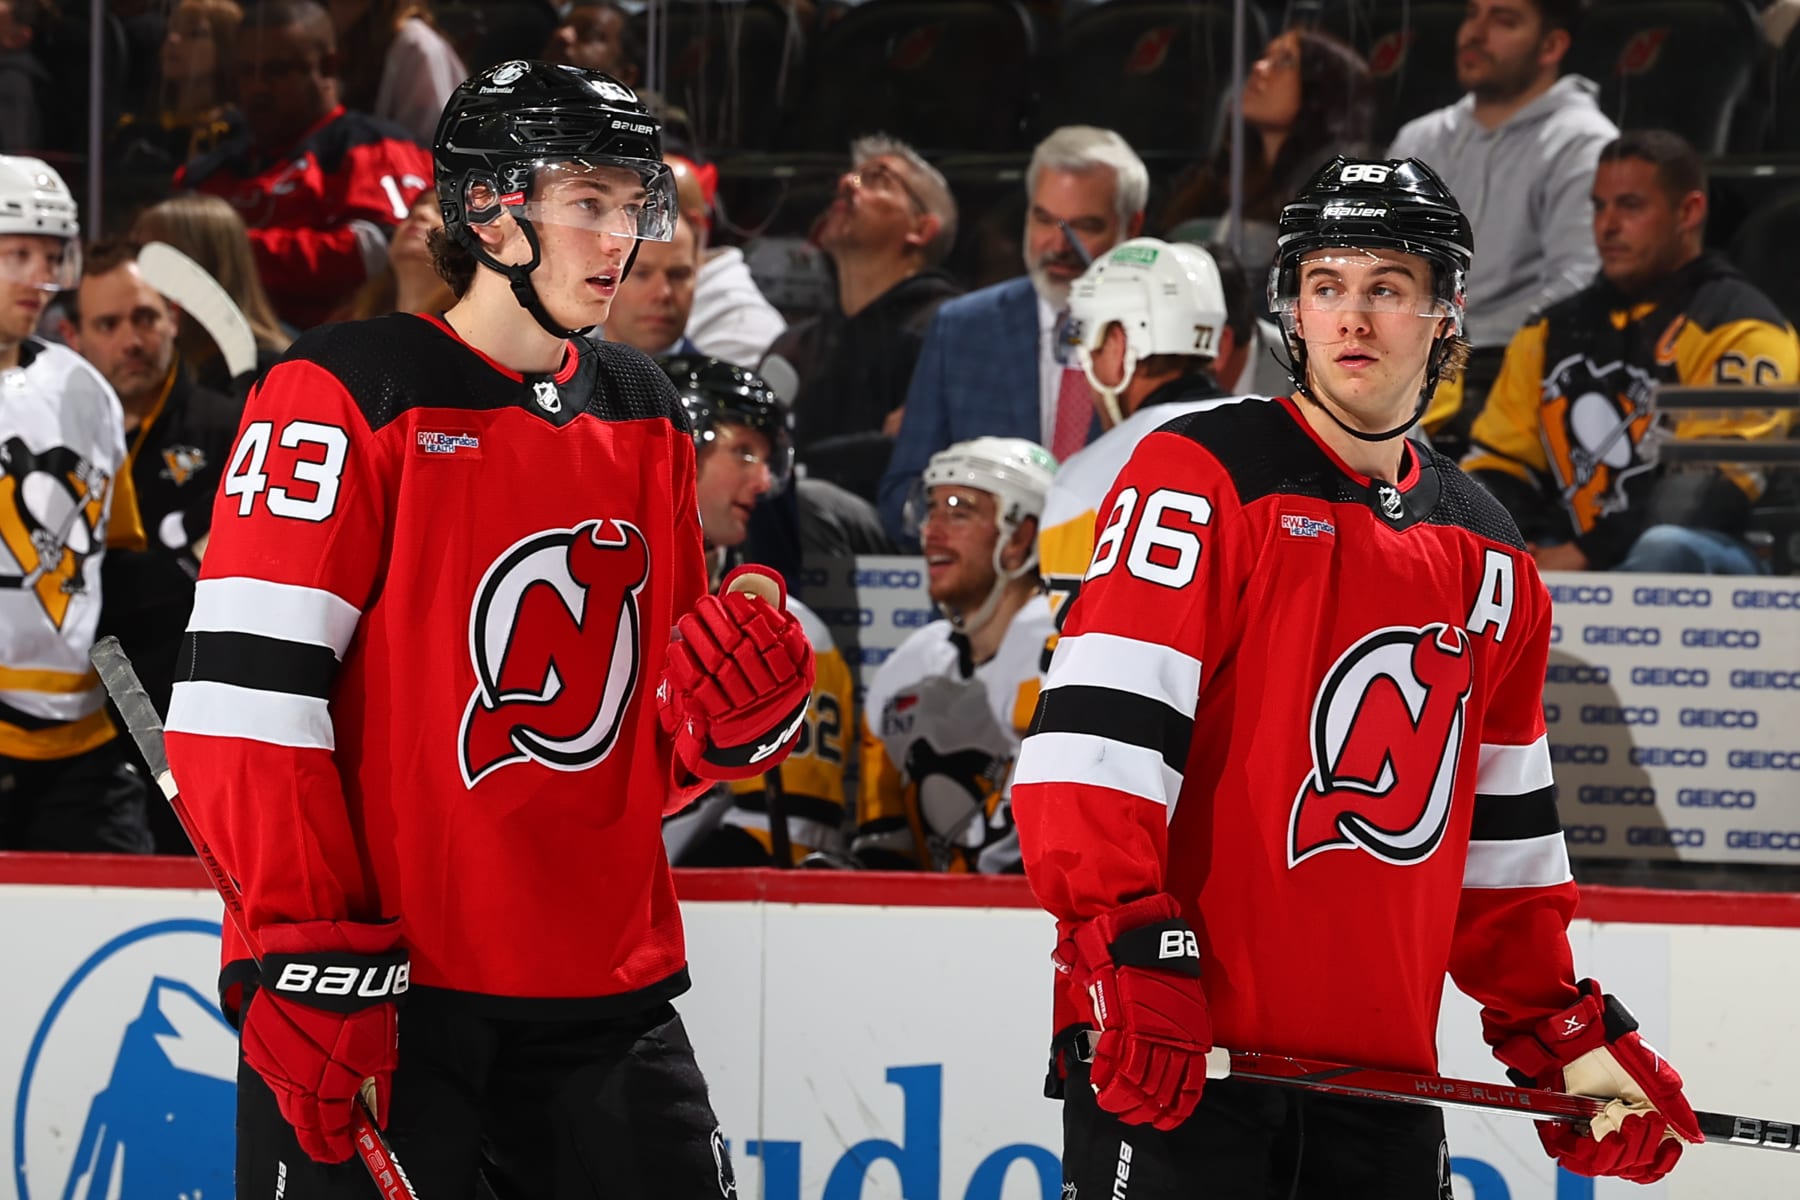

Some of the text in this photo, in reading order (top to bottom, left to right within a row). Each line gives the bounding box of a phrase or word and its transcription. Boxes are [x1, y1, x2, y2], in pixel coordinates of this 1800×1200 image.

[1340, 164, 1393, 183] 86
[1194, 324, 1214, 349] 77
[225, 419, 350, 523] 43
[1084, 486, 1213, 590] 86
[1464, 547, 1516, 644] A
[1551, 586, 1613, 604] EICO
[1633, 587, 1711, 607] GEICO
[1583, 626, 1661, 646] GEICO
[1681, 628, 1760, 649] GEICO
[1546, 665, 1610, 684] EICO
[1631, 667, 1709, 687] GEICO
[1580, 705, 1659, 725] GEICO
[1679, 708, 1758, 729] GEICO
[1549, 744, 1608, 763] EICO
[1629, 747, 1707, 767] GEICO
[1578, 785, 1756, 809] GEICO GEICO
[1626, 827, 1704, 847] GEICO
